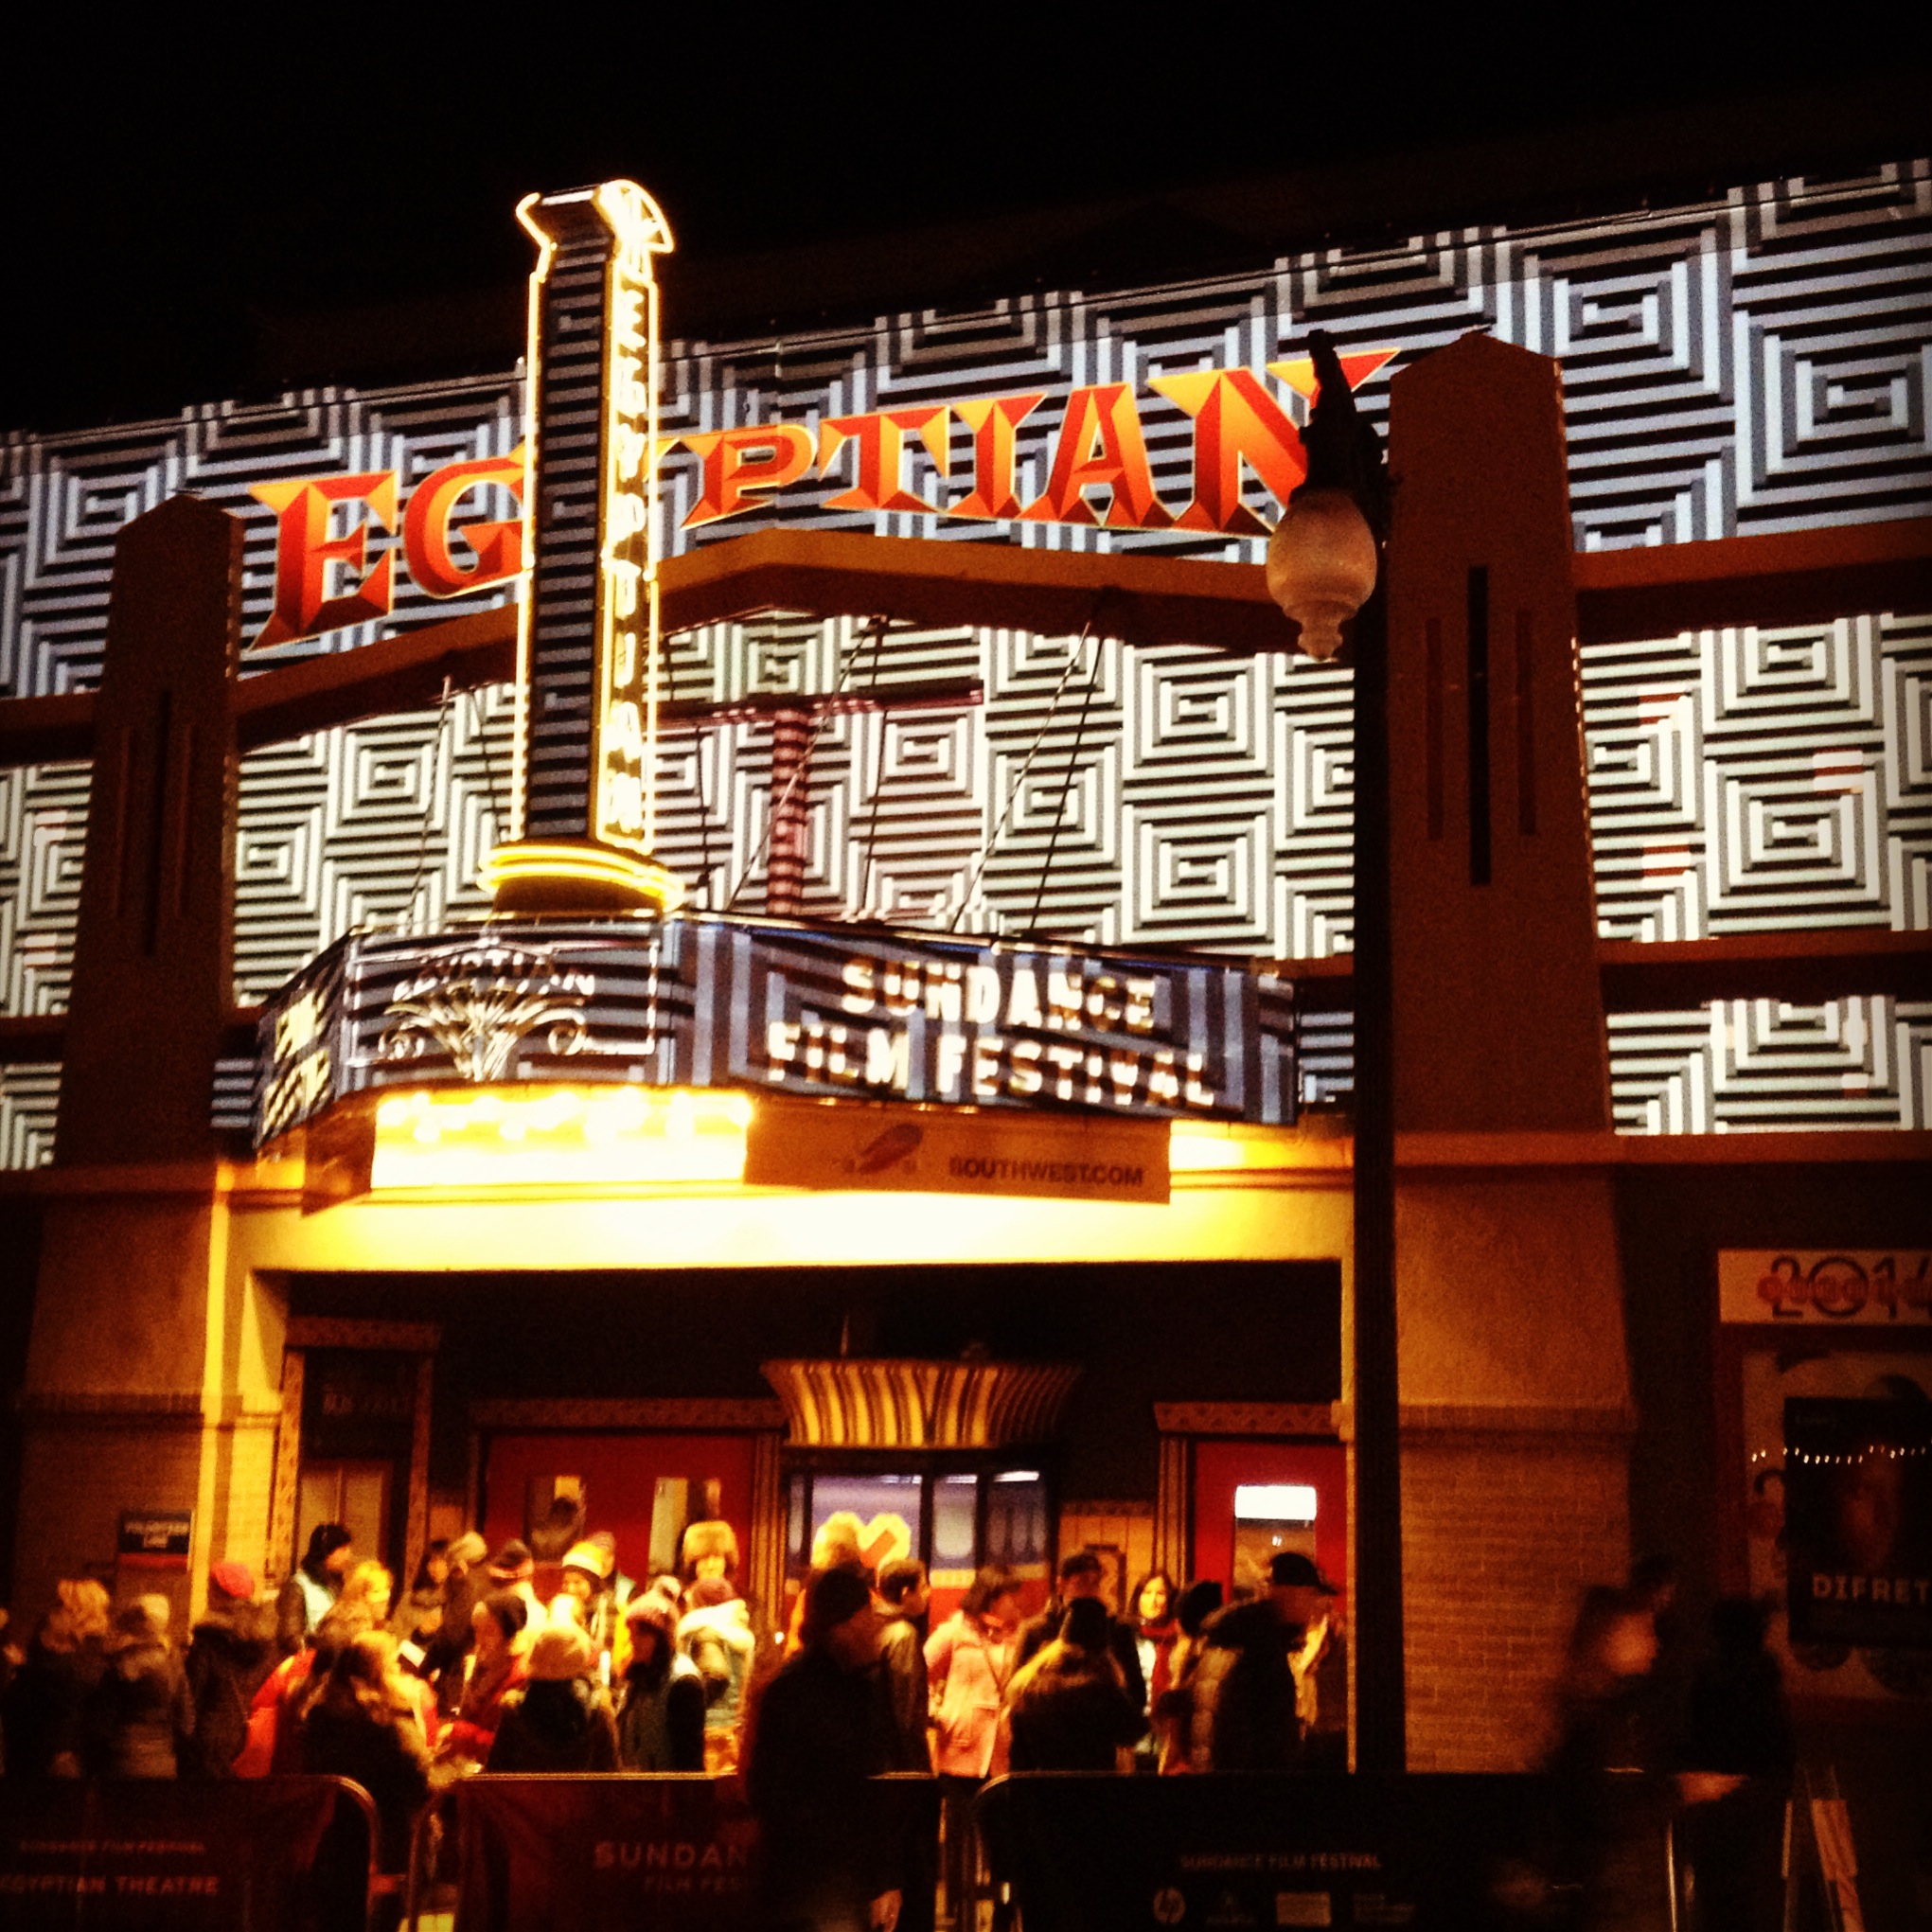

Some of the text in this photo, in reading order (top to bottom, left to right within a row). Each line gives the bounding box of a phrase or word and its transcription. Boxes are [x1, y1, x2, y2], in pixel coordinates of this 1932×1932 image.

[250, 347, 1400, 650] EGPTIAN
[842, 960, 1156, 1031] SUNDANCE
[768, 1020, 1214, 1106] FILM FESTIVAL
[949, 1156, 1143, 1187] SOUTHWEST.COM
[1812, 1572, 1930, 1605] DIFRET
[115, 1874, 220, 1895] THEATRE
